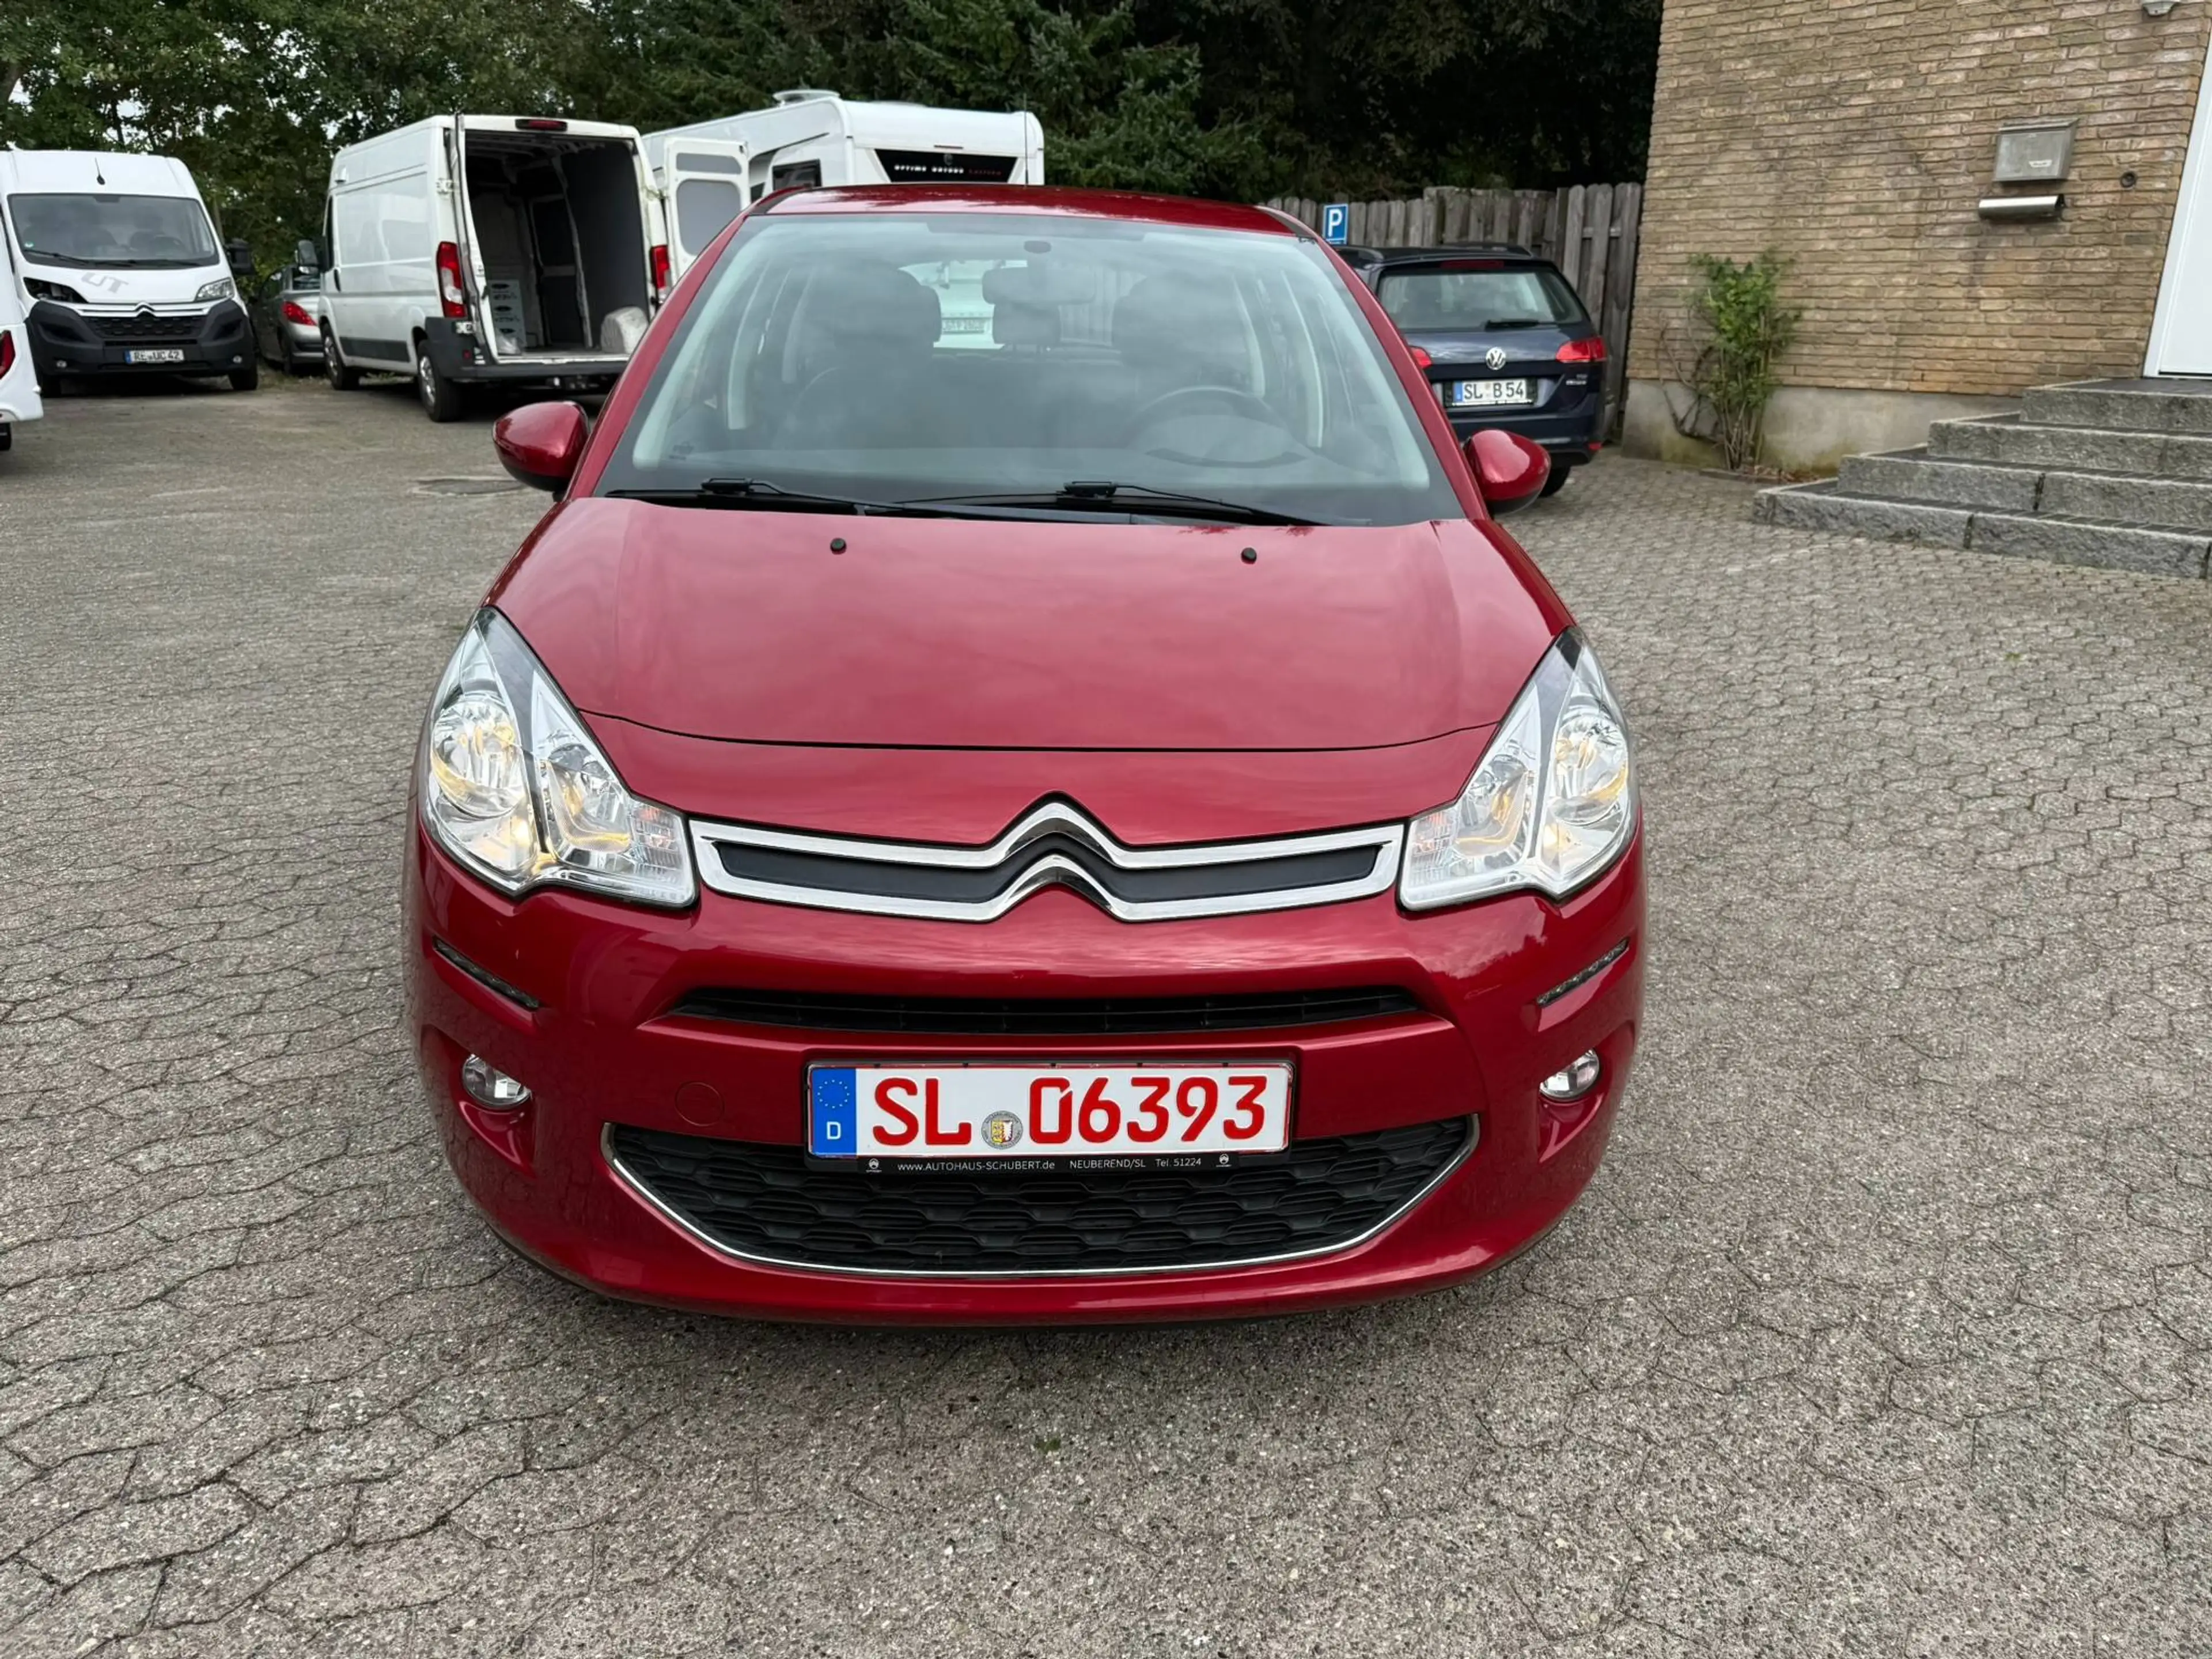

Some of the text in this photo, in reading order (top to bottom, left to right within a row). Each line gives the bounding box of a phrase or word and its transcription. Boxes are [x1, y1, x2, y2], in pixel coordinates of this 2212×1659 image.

[1328, 209, 1343, 237] P
[1464, 381, 1524, 399] SL B 54
[873, 1077, 972, 1146] SL
[1029, 1075, 1267, 1145] 06393
[827, 1121, 841, 1140] D
[897, 1160, 1055, 1171] www.AUTOHAUS-SCHUBERT.de
[1070, 1159, 1146, 1169] NEUBEREND/SL
[1173, 1158, 1202, 1167] 51224
